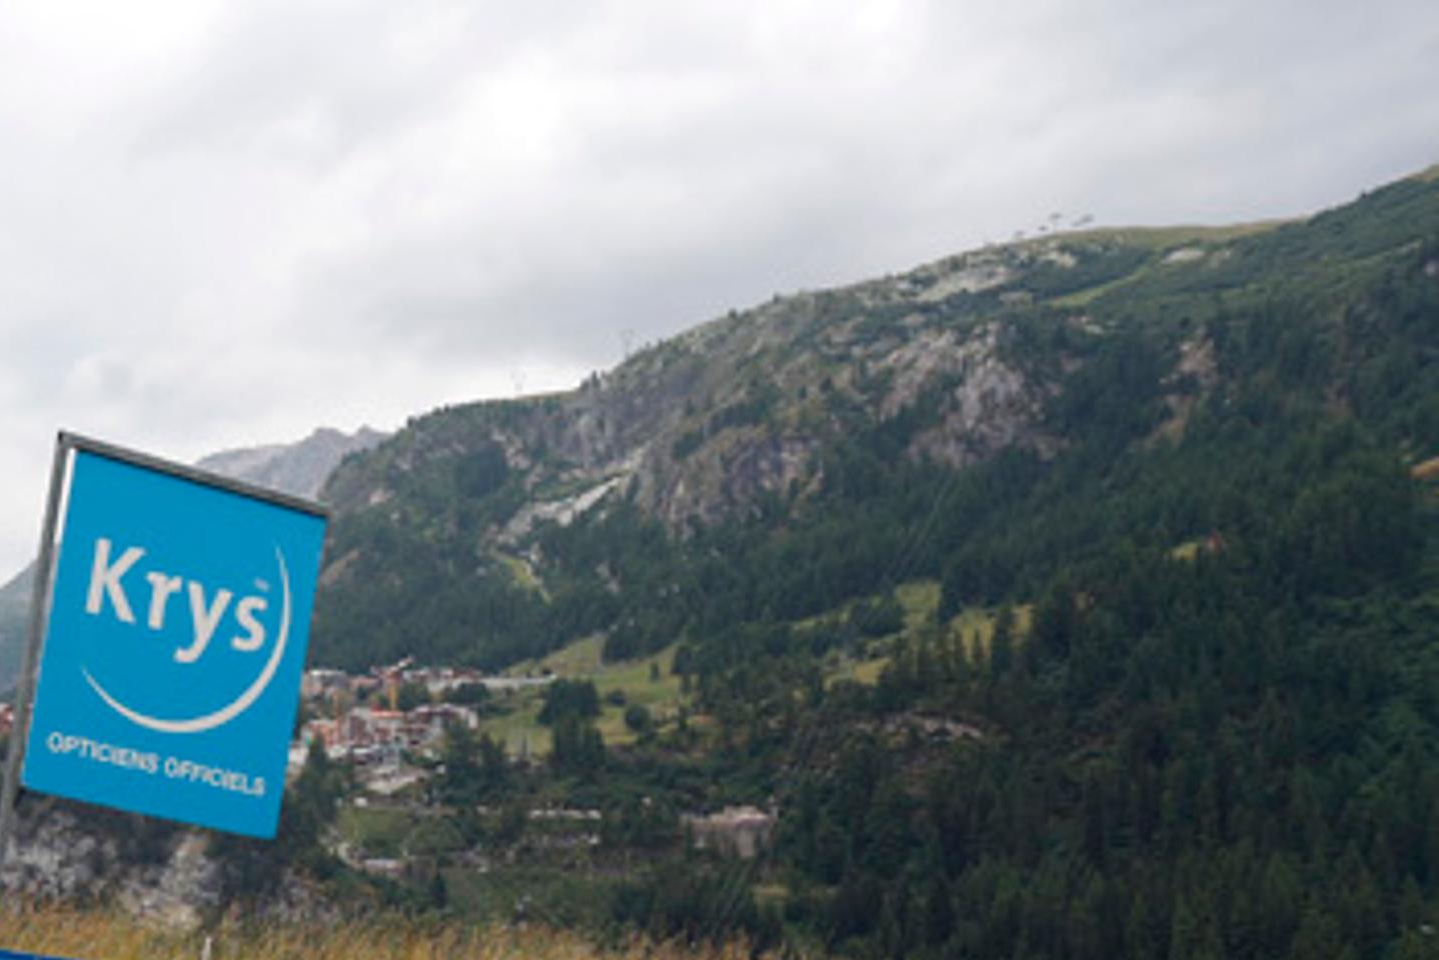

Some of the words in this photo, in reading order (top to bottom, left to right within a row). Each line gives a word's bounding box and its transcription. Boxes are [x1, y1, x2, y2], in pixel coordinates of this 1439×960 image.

[85, 538, 268, 663] Krys
[46, 731, 160, 774] OPTICIENS
[163, 756, 265, 797] OFFICIELS
